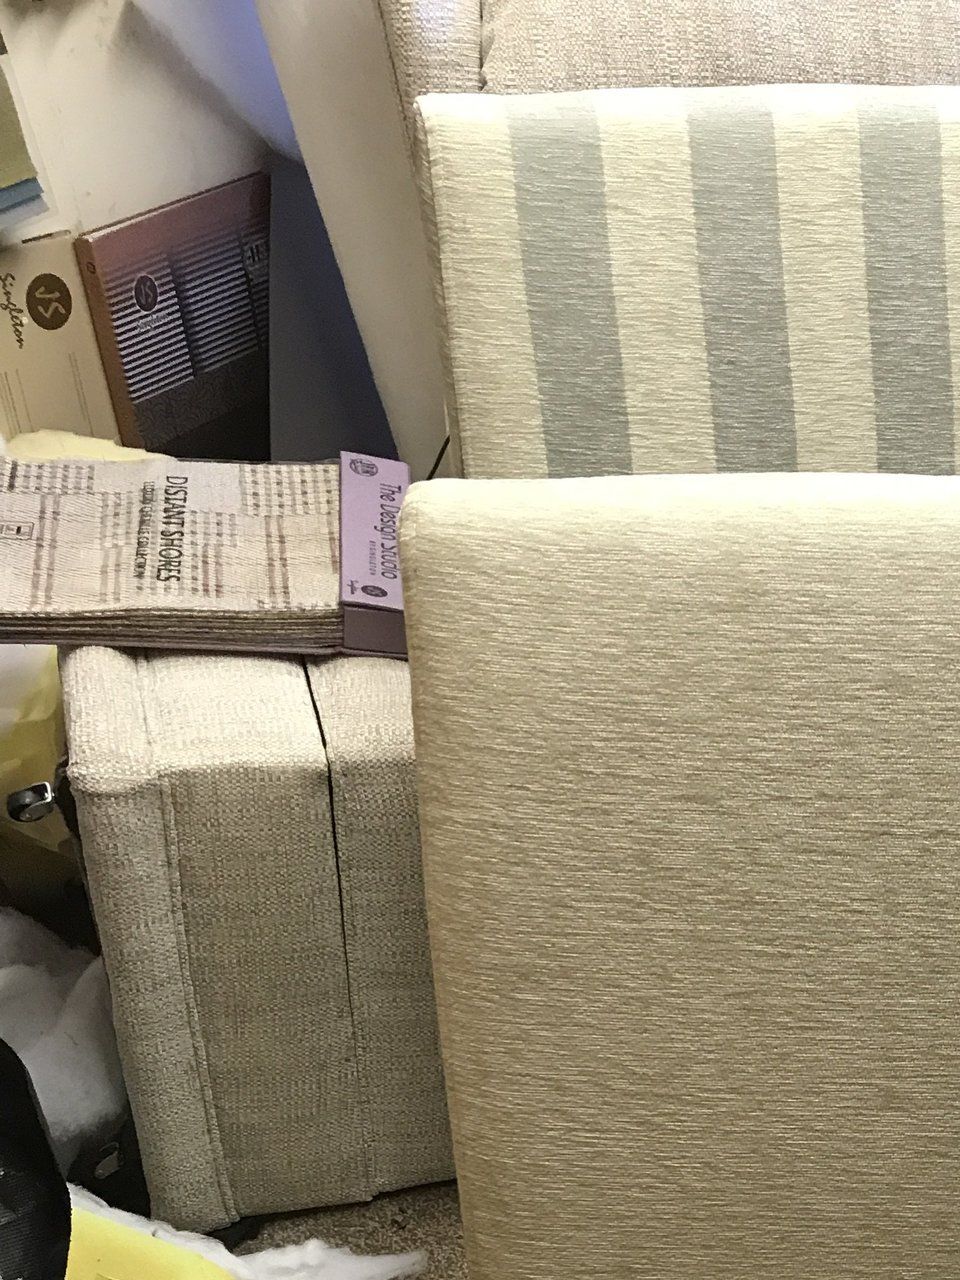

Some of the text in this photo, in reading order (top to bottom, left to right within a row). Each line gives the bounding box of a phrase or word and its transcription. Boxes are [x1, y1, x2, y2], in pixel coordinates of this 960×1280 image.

[0, 272, 25, 349] Singleton
[379, 482, 402, 503] The
[156, 476, 188, 582] DISTANT SHORES
[374, 503, 400, 541] Design
